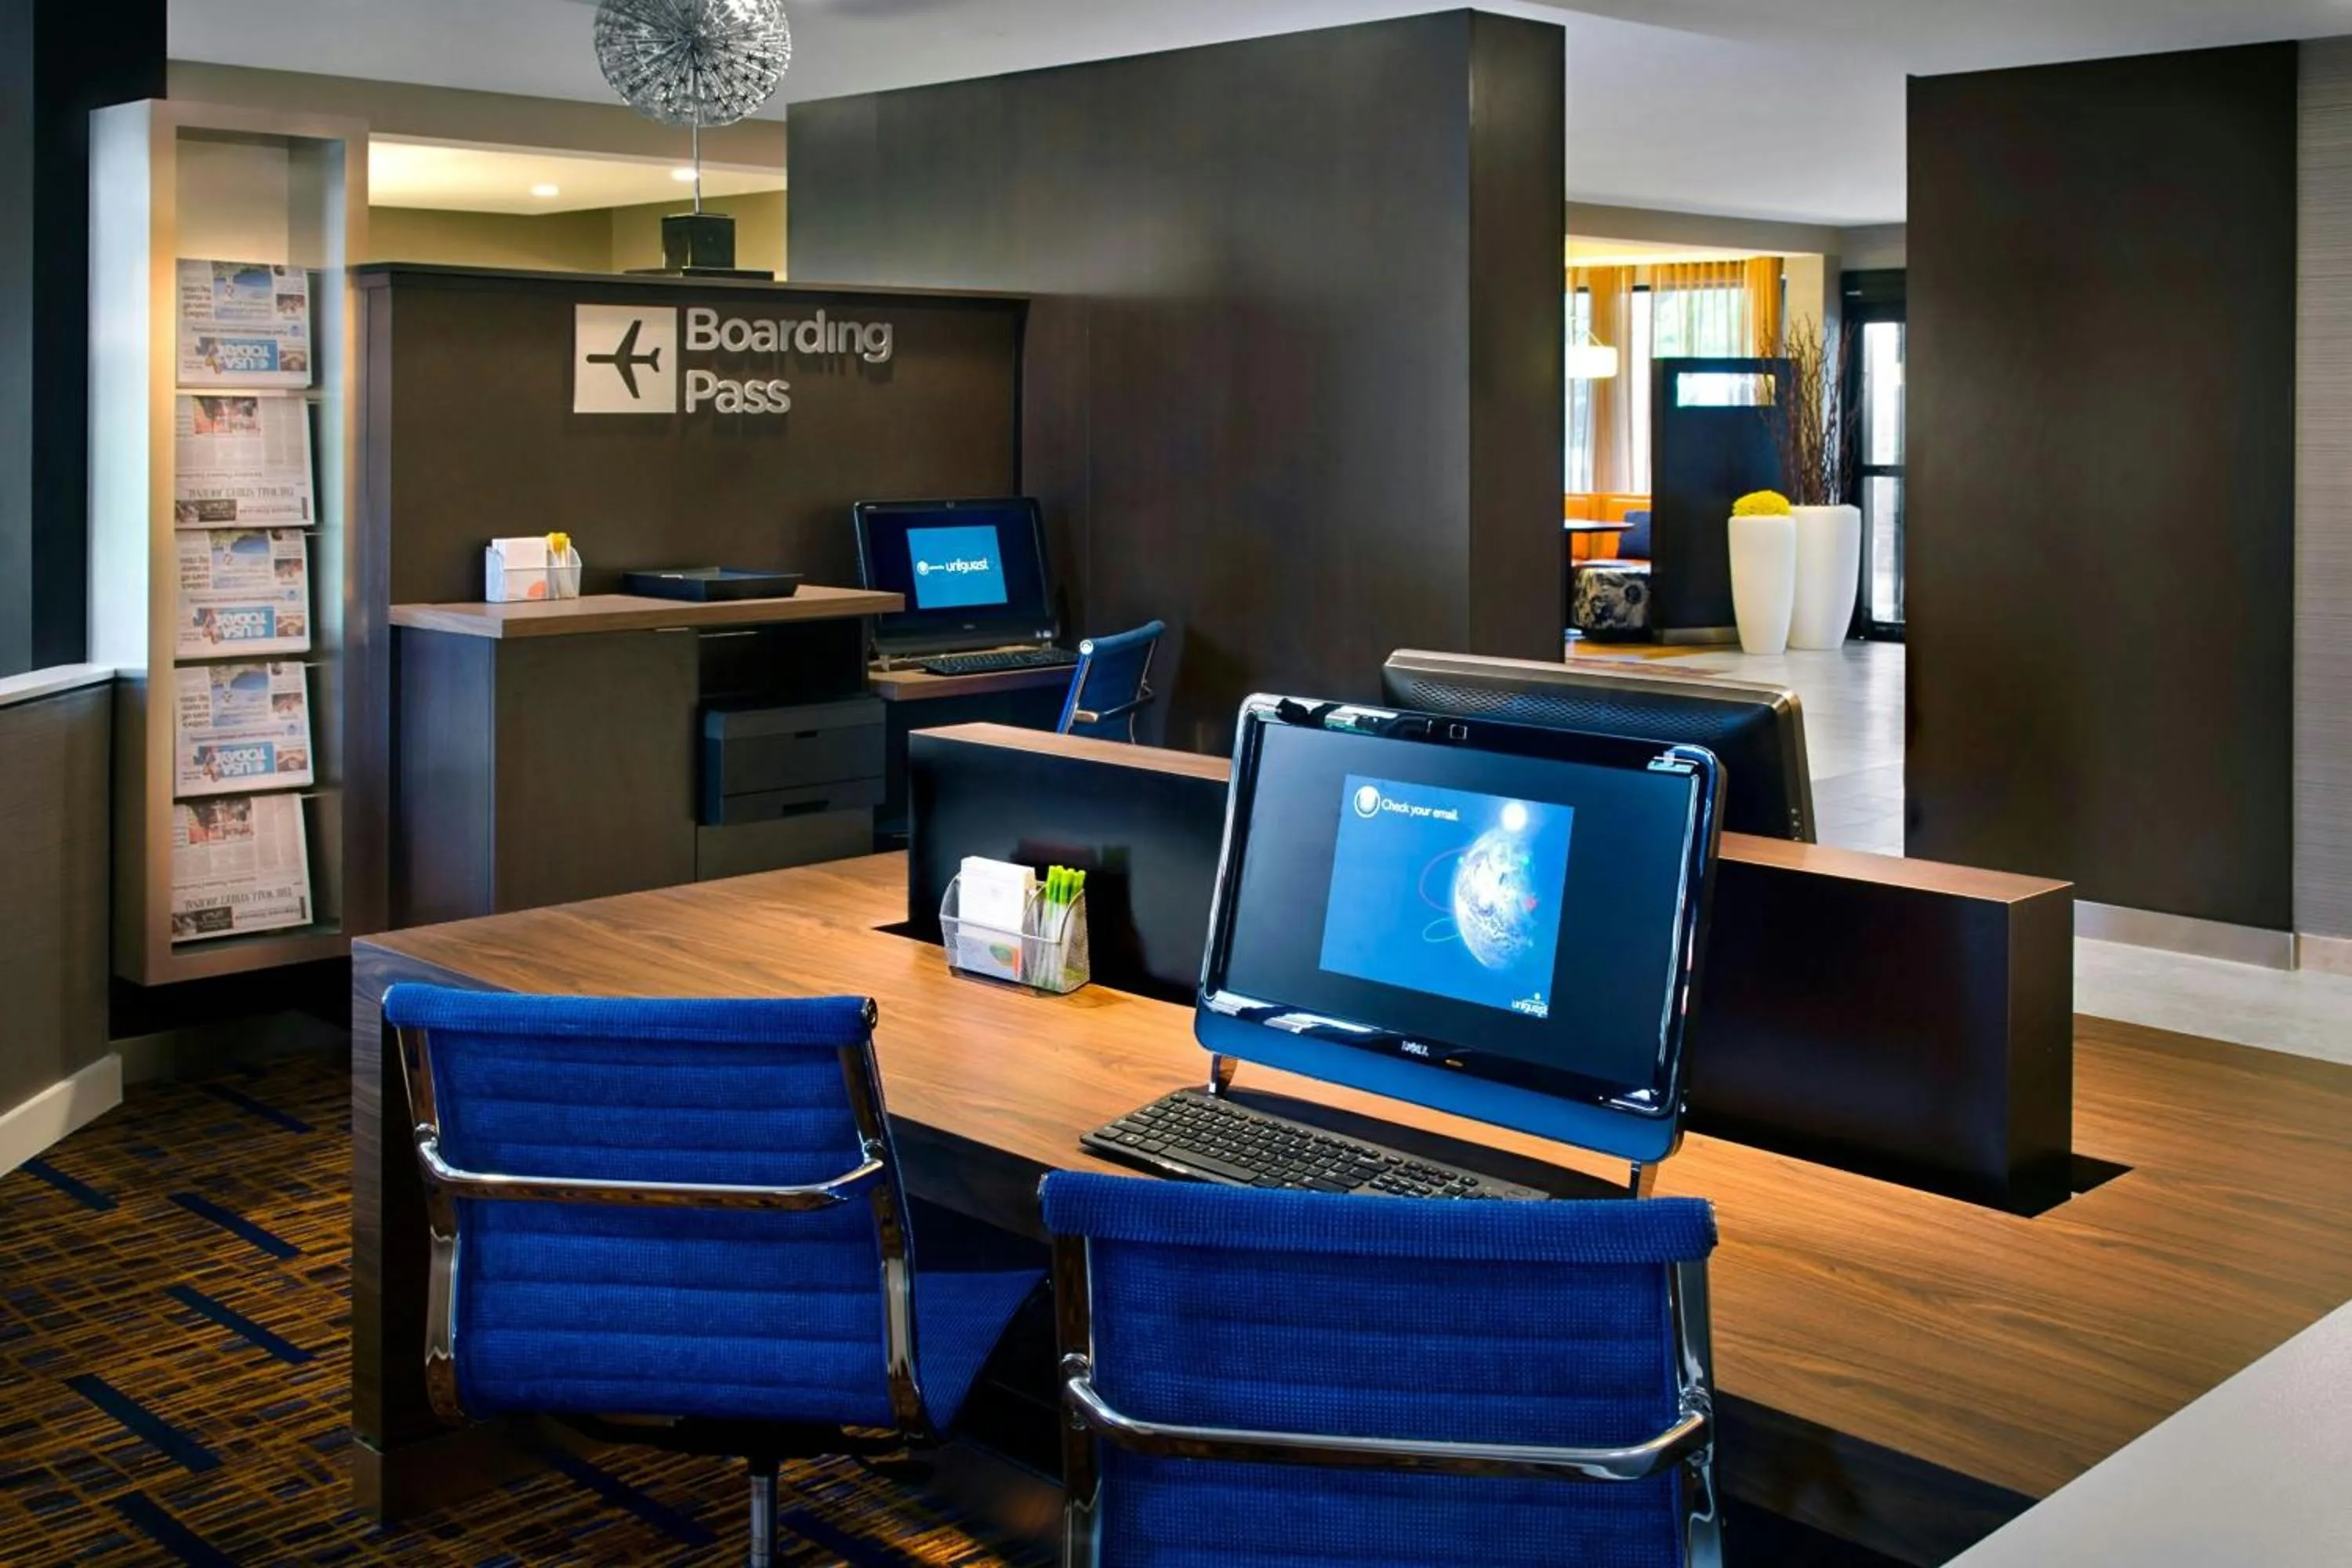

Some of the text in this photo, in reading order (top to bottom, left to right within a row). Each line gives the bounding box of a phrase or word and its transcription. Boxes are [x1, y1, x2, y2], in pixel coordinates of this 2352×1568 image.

[685, 307, 893, 363] Boarding
[225, 358, 255, 370] USA
[685, 369, 791, 414] Pass
[946, 558, 989, 574] uniguest
[222, 626, 252, 638] USA
[222, 762, 252, 775] USA
[1381, 799, 1410, 813] Check
[1410, 806, 1432, 817] your
[1402, 1040, 1429, 1057] DELL
